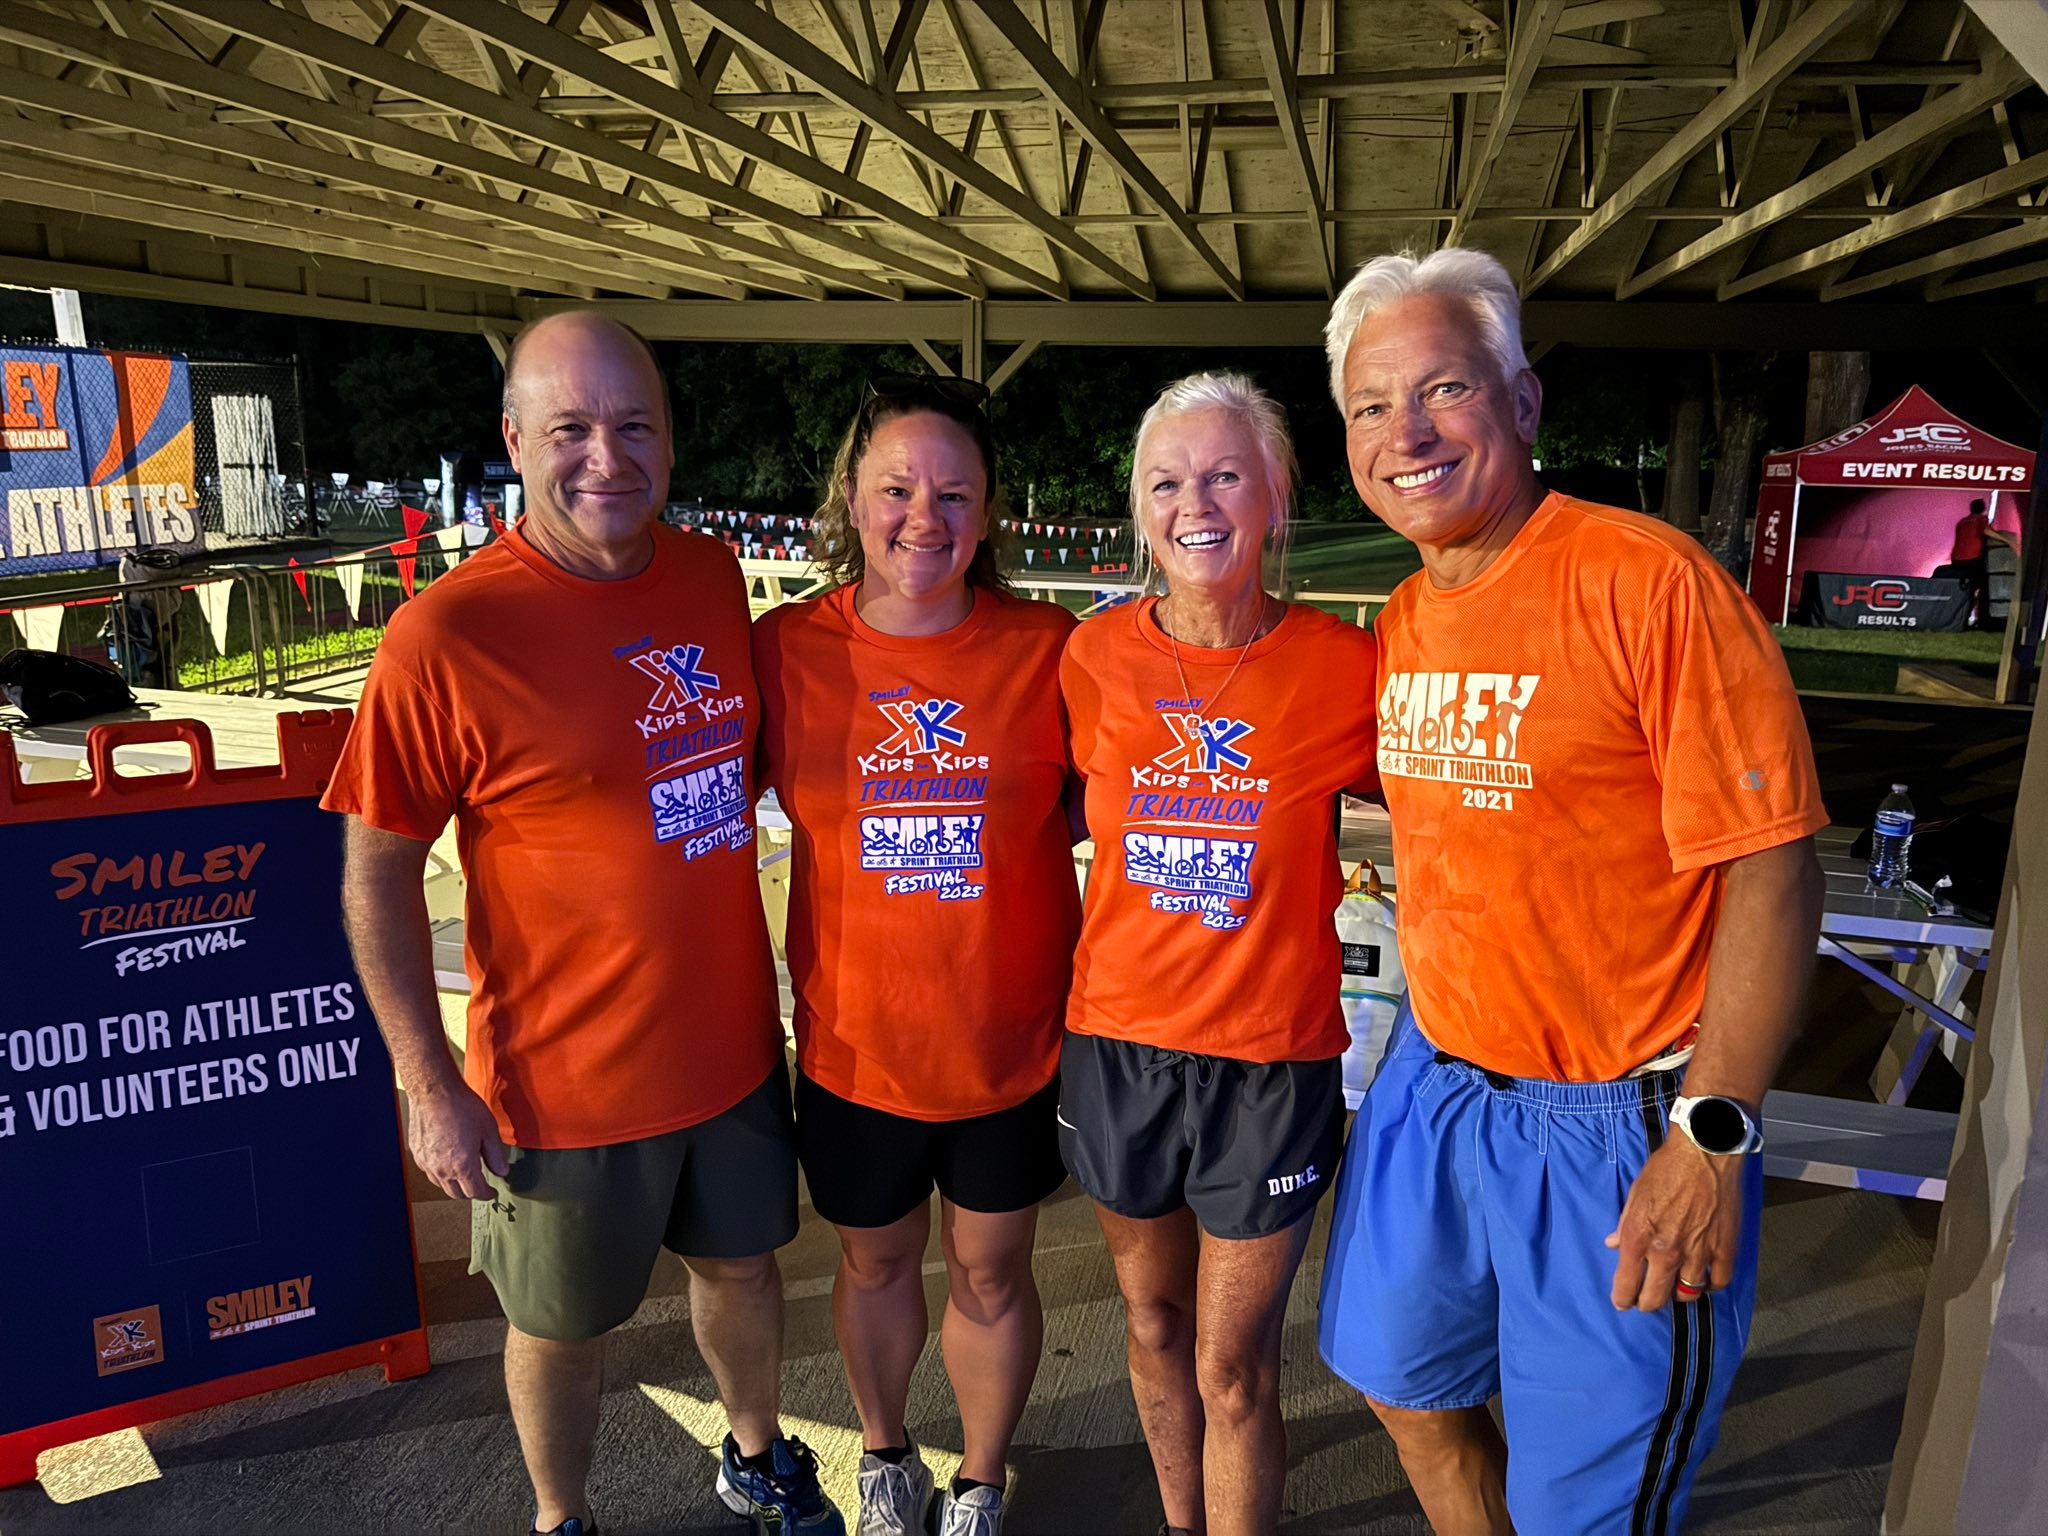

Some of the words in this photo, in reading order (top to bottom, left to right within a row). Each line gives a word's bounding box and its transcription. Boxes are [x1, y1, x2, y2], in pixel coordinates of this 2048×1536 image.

[0, 361, 59, 428] EY
[1879, 423, 1971, 445] JRC
[1842, 463, 1918, 478] EVENT
[1922, 463, 2026, 482] RESULTS
[8, 482, 196, 558] ATHLETES
[1832, 580, 1910, 611] JRC
[1857, 615, 1917, 627] RESULTS
[868, 685, 911, 702] SMILEY
[1377, 671, 1541, 760] SMILEY
[646, 717, 745, 768] TRIATHLON
[1405, 755, 1446, 778] SPRINT
[1449, 759, 1530, 786] TRIATHLON
[860, 776, 988, 801] TRIATHLON
[1461, 787, 1513, 811] 2021
[1125, 793, 1264, 823] TRIATHLON
[684, 816, 746, 860] FESTIVAL
[861, 815, 984, 856] SMILEY
[50, 842, 266, 900] SMILEY
[900, 856, 930, 867] SPRINT
[933, 855, 978, 866] TRIATHLON
[1124, 832, 1256, 883] SMILEY
[885, 869, 967, 895] FESTIVAL
[939, 884, 983, 900] 2025
[1164, 876, 1196, 889] SPRINT
[1199, 880, 1247, 896] TRIATHLON
[79, 889, 257, 936] TRIATHLON
[1150, 891, 1231, 913] FESTIVAL
[1202, 911, 1247, 929] 2025
[115, 927, 246, 977] FESTIVAL
[99, 1010, 171, 1058] FOR
[183, 982, 355, 1046] ATHLETES
[26, 1053, 269, 1132] VOLUNTEERS
[277, 1037, 361, 1088] ONLY
[207, 1275, 312, 1329] SMILEY
